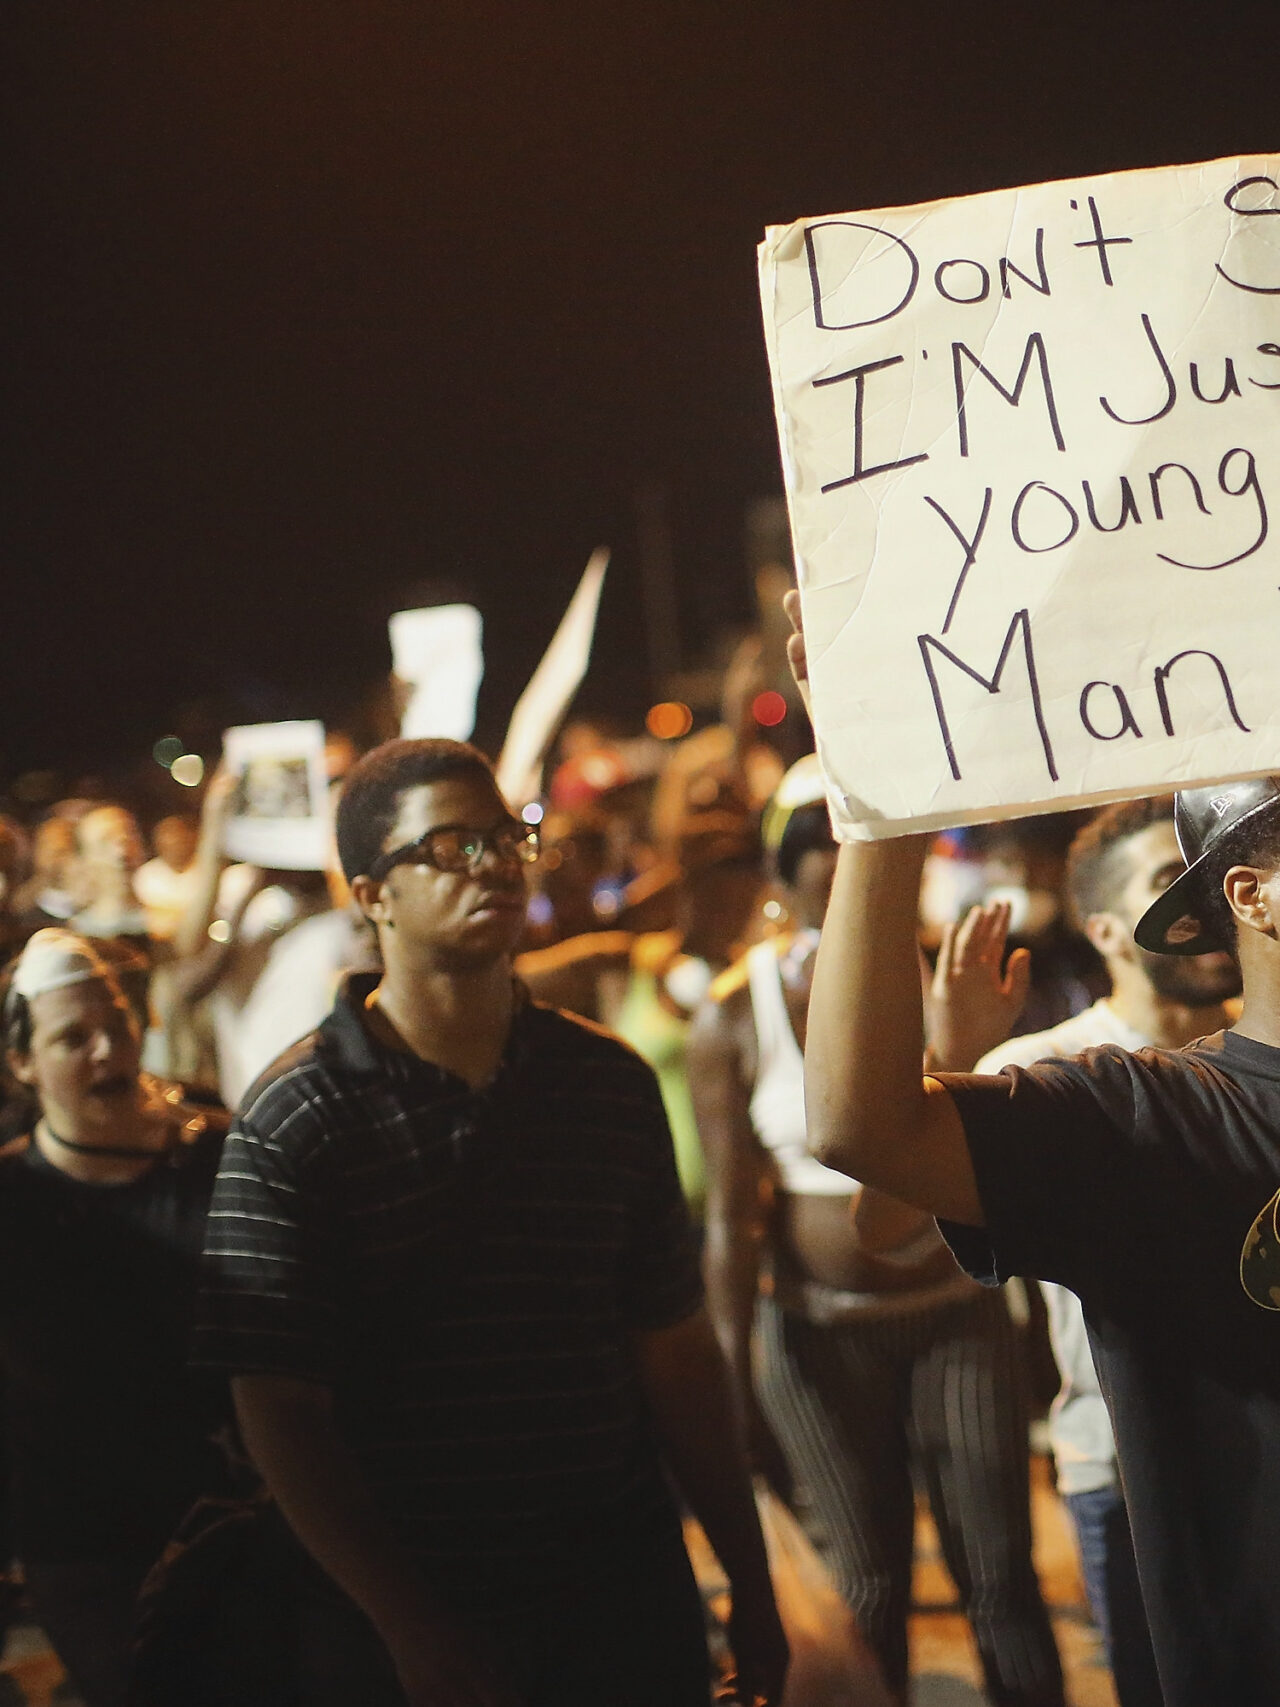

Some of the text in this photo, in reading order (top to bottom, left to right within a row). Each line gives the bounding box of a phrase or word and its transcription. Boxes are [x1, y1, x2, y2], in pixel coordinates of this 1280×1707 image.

[811, 331, 1066, 494] I'M
[922, 446, 1269, 635] young
[916, 608, 1252, 783] Man
